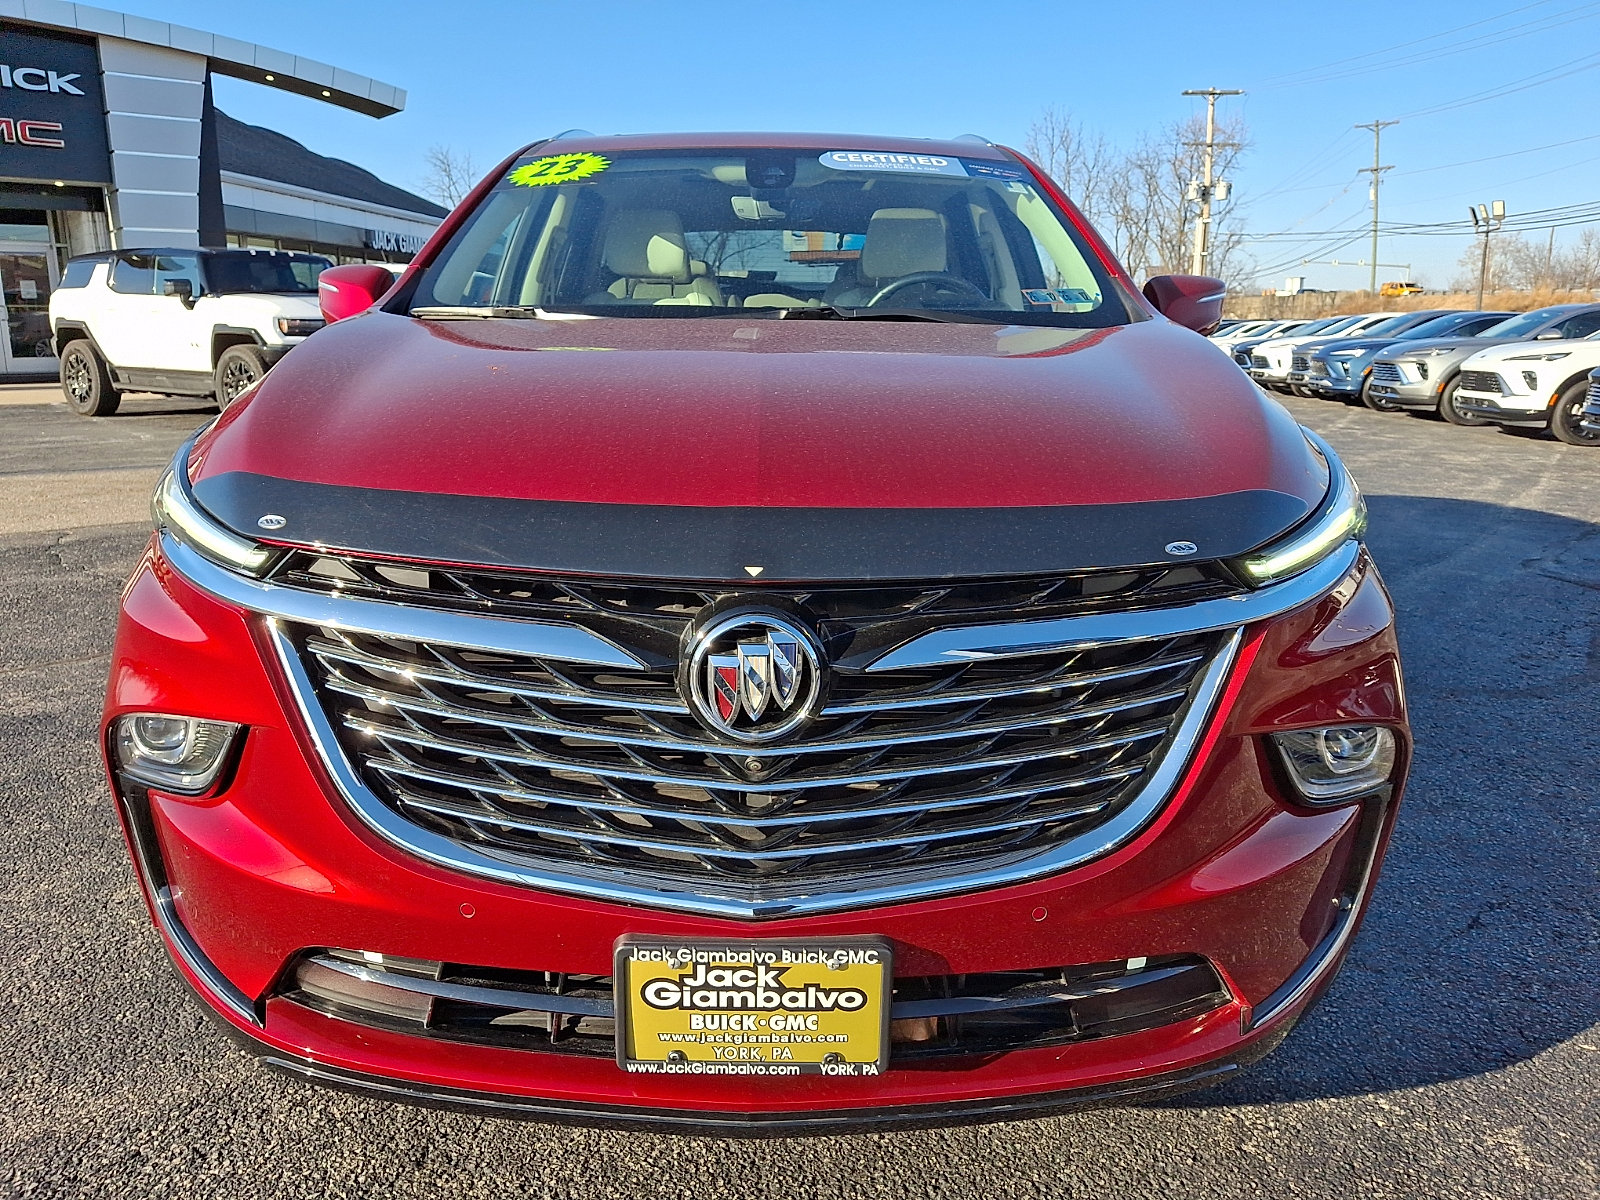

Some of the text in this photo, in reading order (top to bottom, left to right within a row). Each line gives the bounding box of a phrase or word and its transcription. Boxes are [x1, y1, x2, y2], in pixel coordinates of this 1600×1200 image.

[832, 153, 948, 166] CERTIFIED
[529, 159, 586, 178] 23
[373, 230, 398, 252] JACK
[629, 946, 879, 964] Jack Giambalvo Buick GMC
[683, 964, 780, 988] Jack
[644, 981, 864, 1009] Giambalvo
[690, 1014, 819, 1031] BUICK GMC
[658, 1032, 849, 1045] www.jackgiambalvo.com
[713, 1046, 793, 1062] YORK, PA
[626, 1062, 880, 1076] www.JackGiambalvo.com YORK, PA
